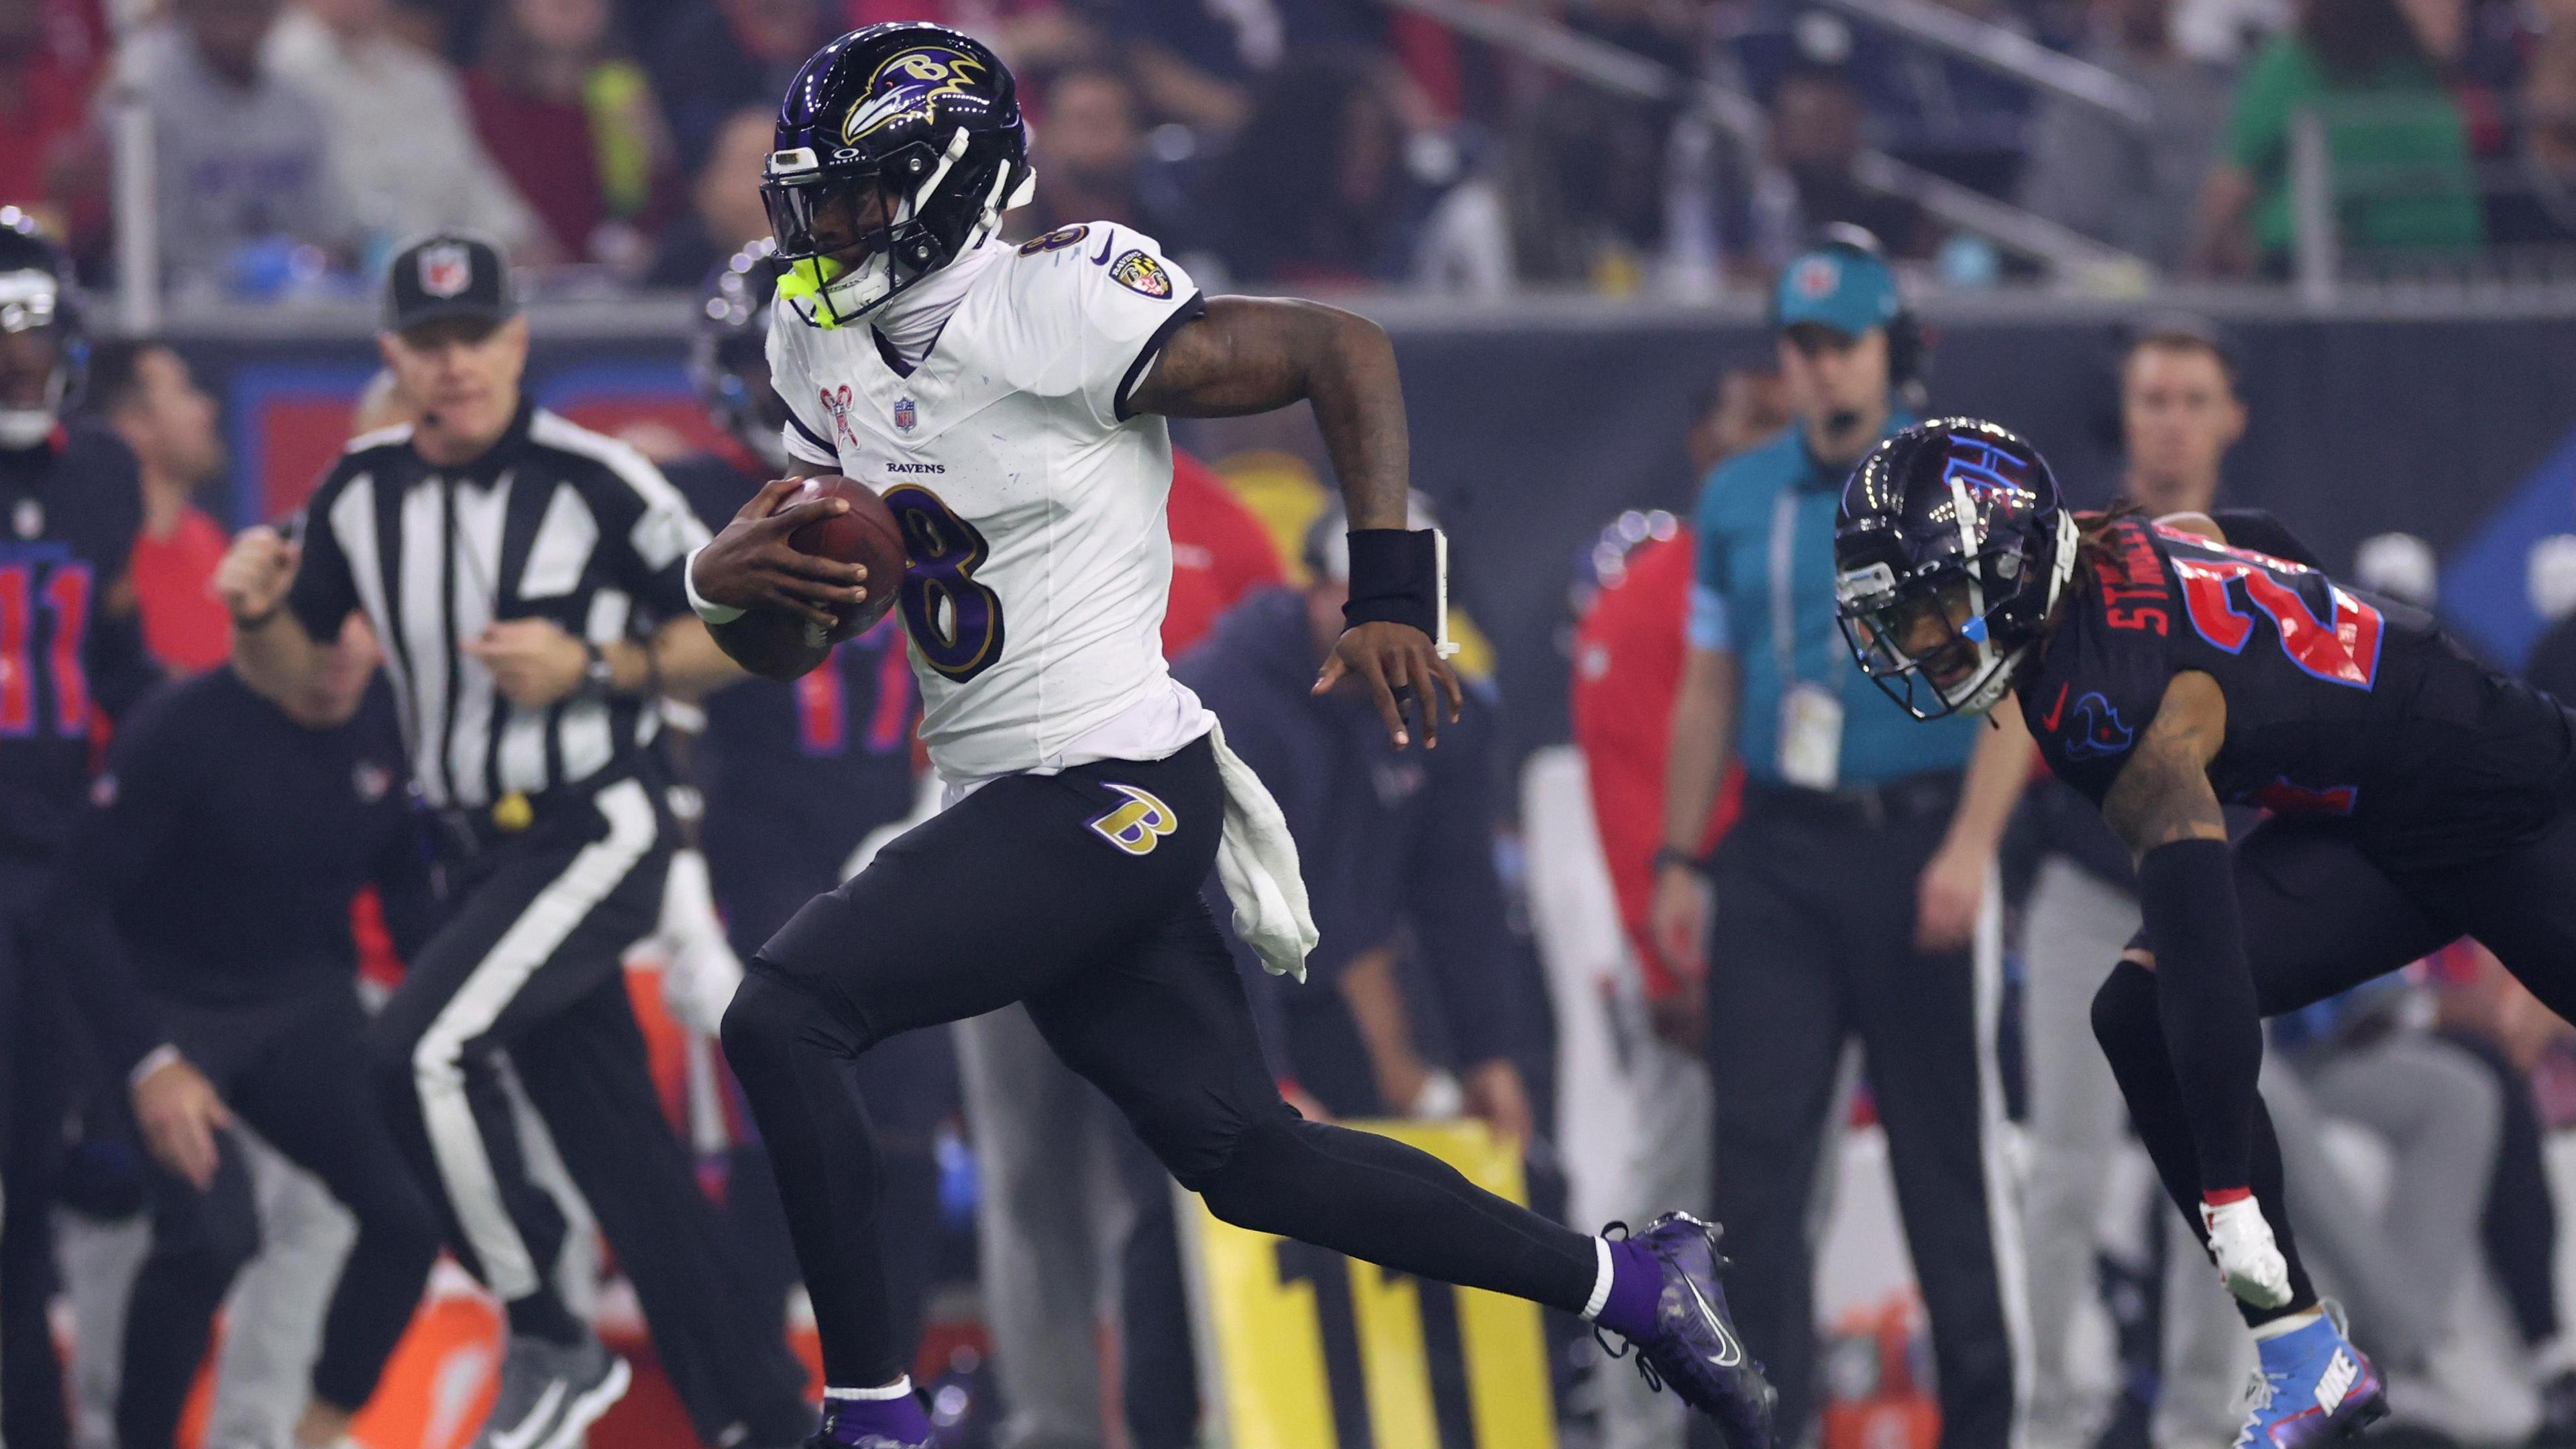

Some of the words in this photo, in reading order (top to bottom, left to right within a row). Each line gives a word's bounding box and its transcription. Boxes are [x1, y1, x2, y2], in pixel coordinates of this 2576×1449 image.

[883, 54, 949, 81] B
[1017, 225, 1089, 258] 8
[1112, 251, 1142, 278] RAVENS
[885, 463, 946, 474] RAVENS
[883, 483, 1006, 684] 8
[2150, 523, 2385, 692] 2
[1082, 780, 1178, 855] B
[2313, 1346, 2359, 1418] NIKE
